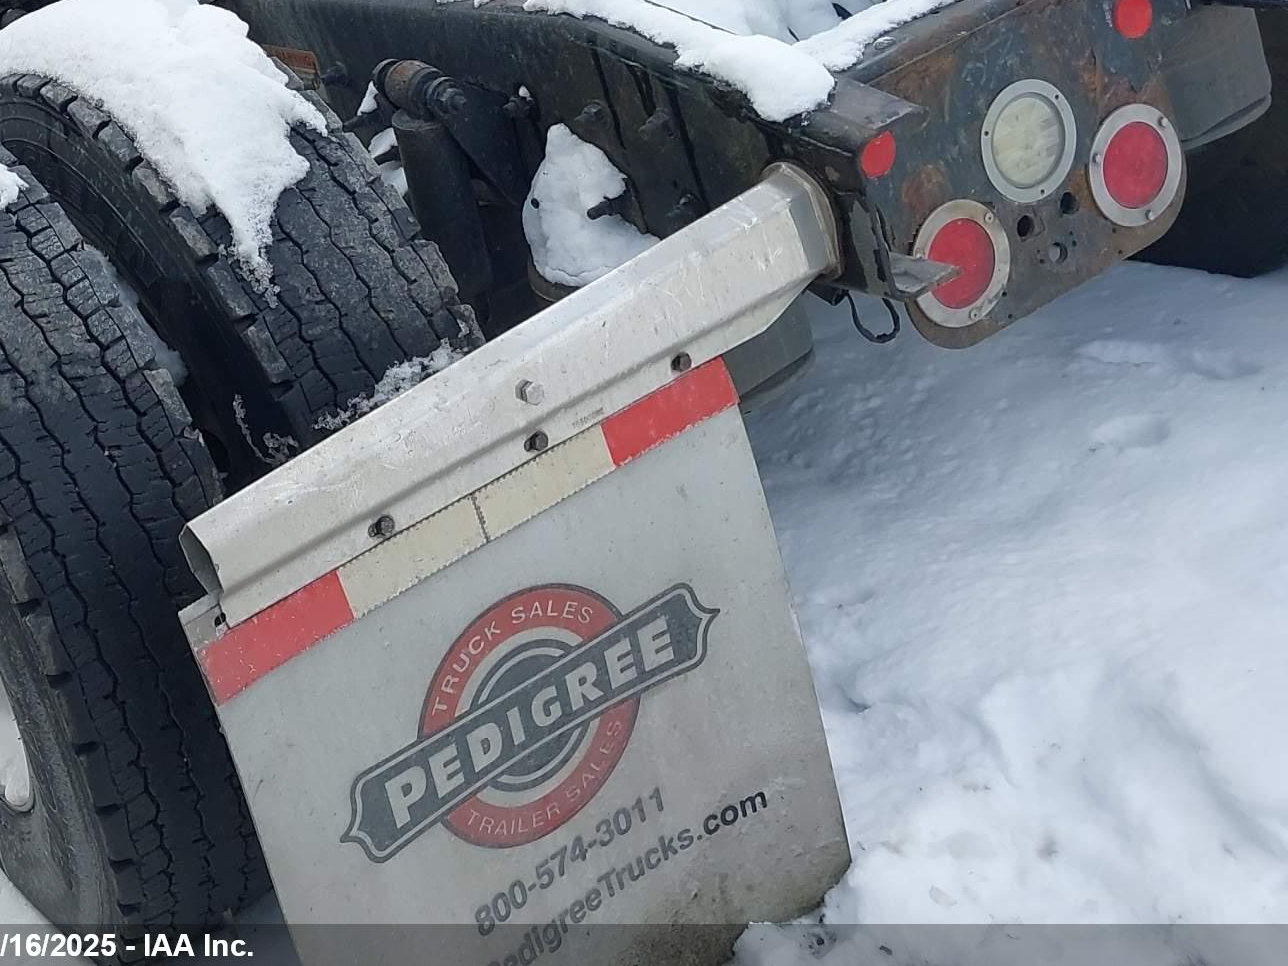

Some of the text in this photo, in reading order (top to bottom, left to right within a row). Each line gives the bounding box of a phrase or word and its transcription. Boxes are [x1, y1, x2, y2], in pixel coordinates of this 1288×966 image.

[384, 614, 675, 830] PEDIGREE
[431, 600, 593, 716] TRUCK SALES
[466, 718, 623, 835] TRAILER SALES
[474, 787, 665, 936] 800-574-3011
